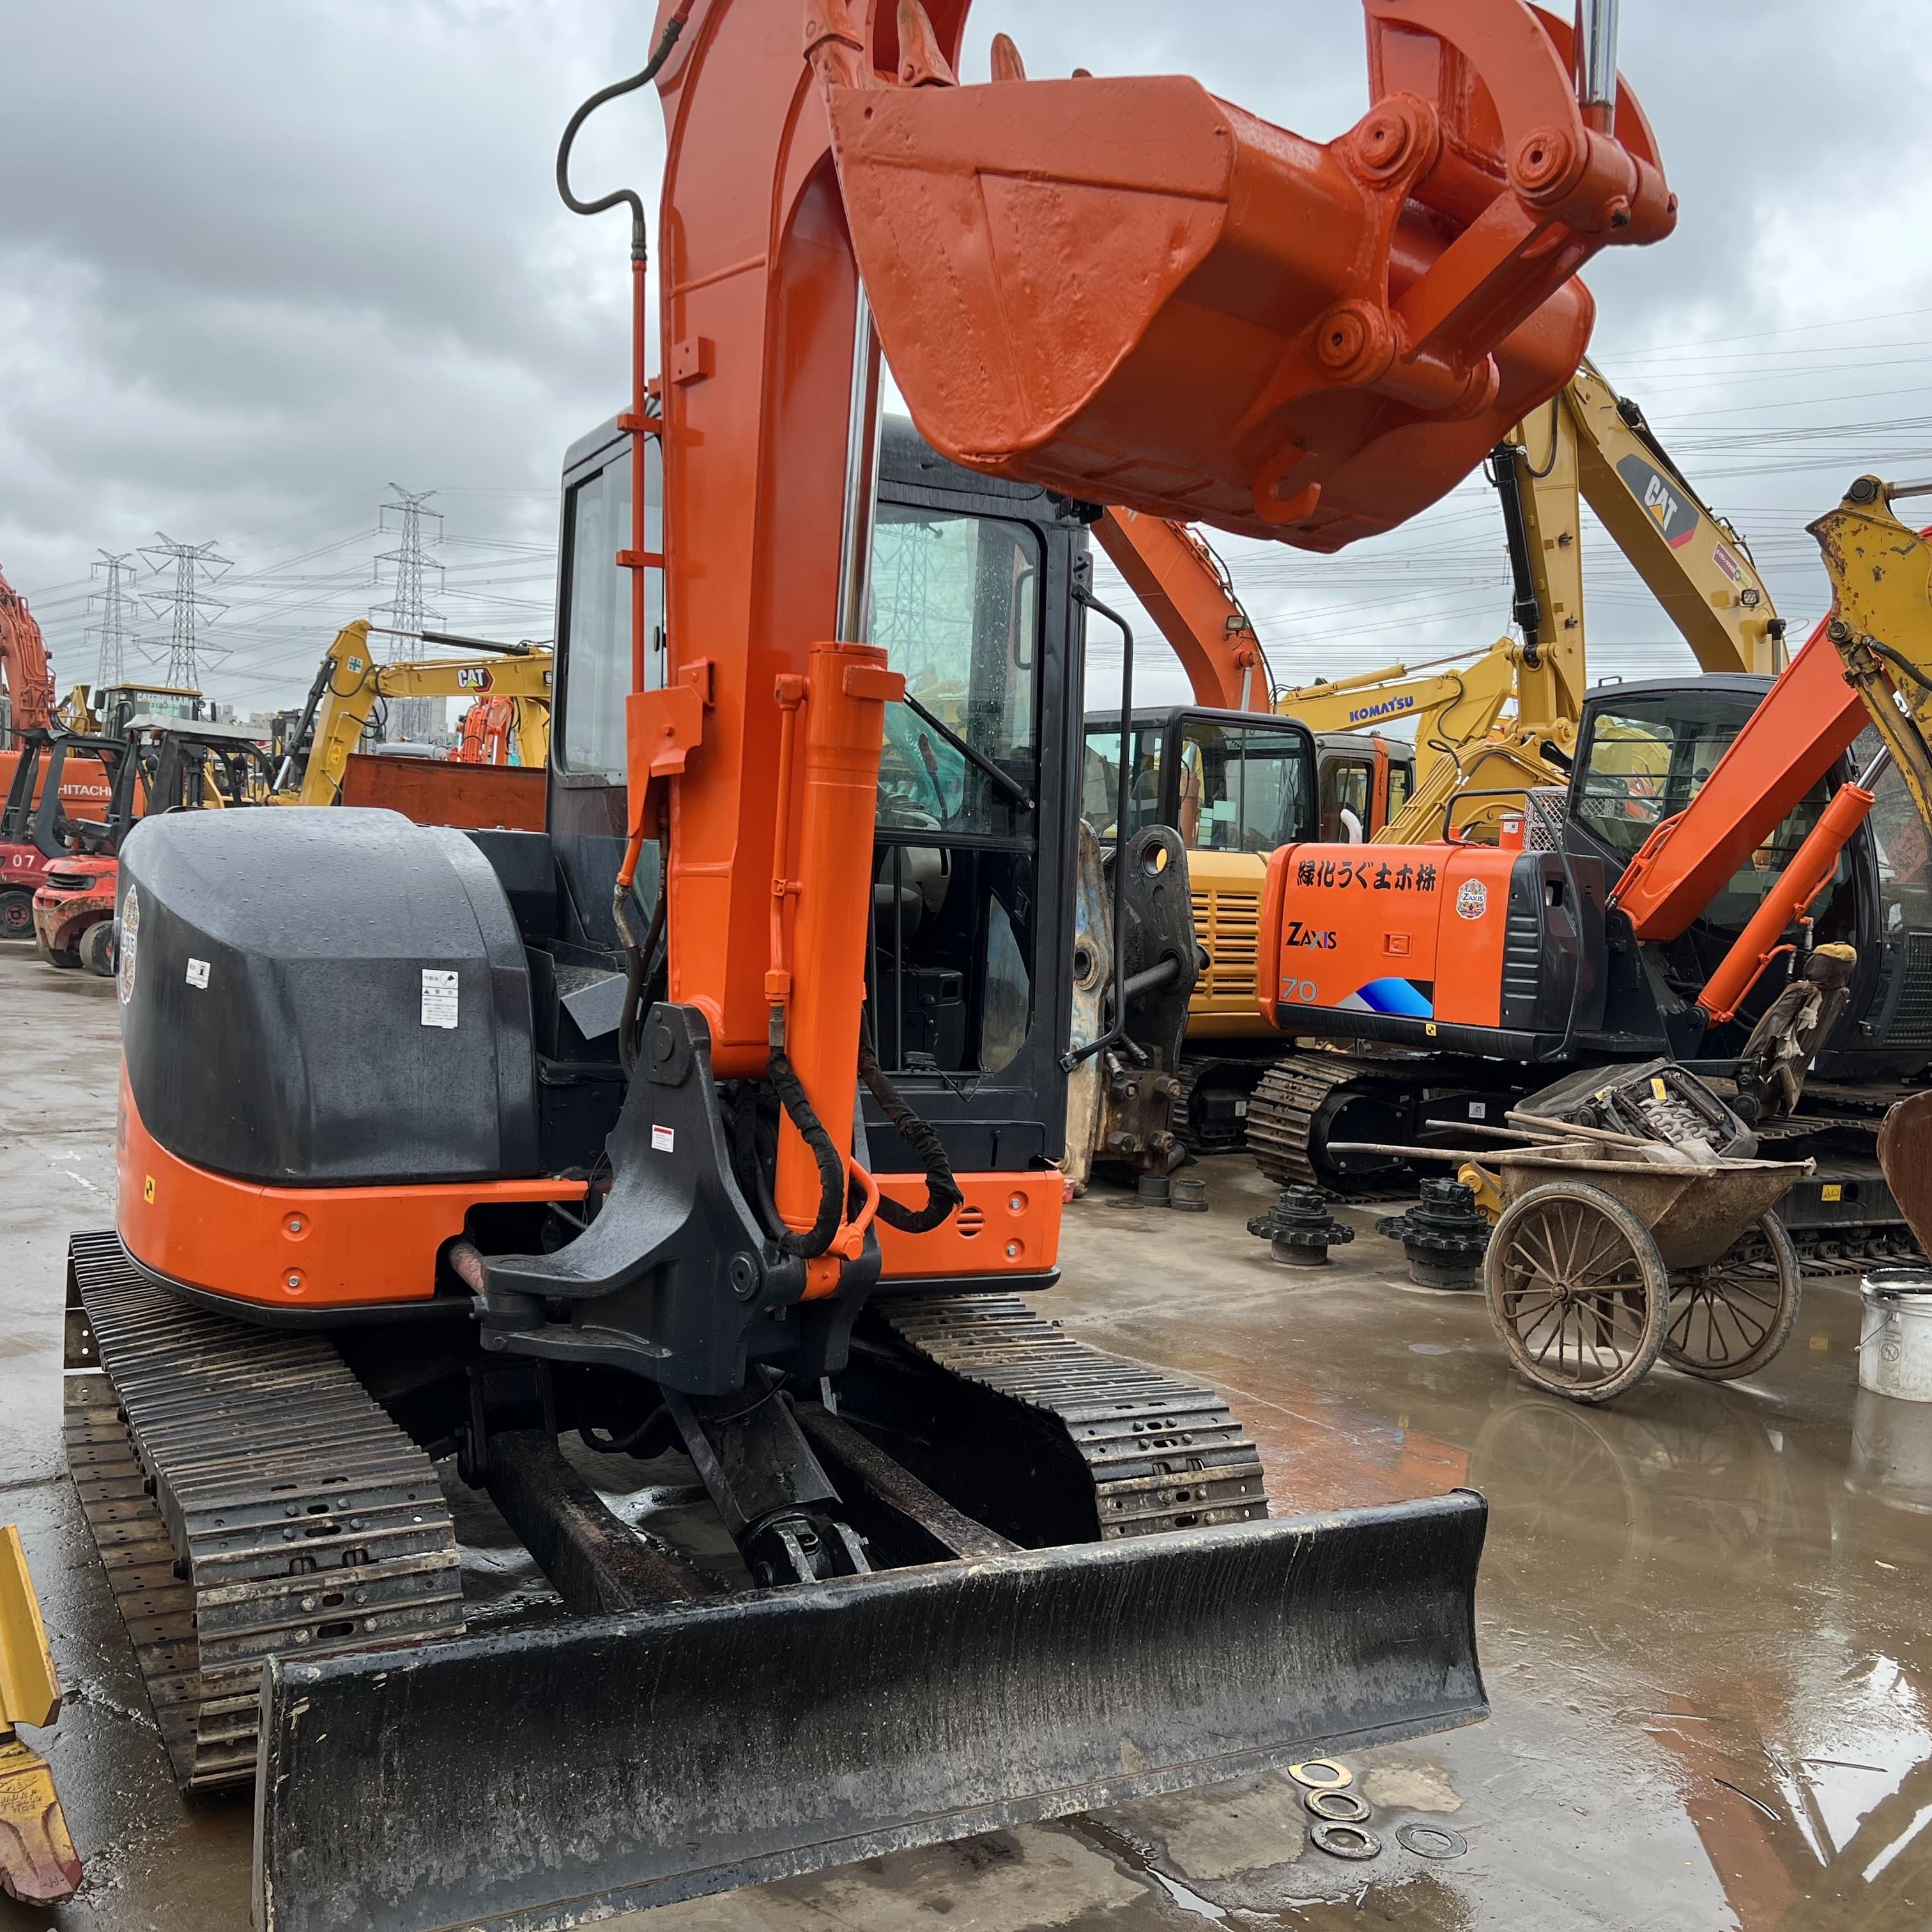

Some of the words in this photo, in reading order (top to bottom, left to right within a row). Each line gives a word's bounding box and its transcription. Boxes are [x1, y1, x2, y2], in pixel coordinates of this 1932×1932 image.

[1644, 475, 1678, 531] CAT
[457, 669, 484, 688] CAT
[1349, 695, 1414, 722] KOMATSU
[13, 855, 34, 867] 07
[1285, 921, 1337, 951] ZAXIS
[1280, 977, 1317, 1002] 70
